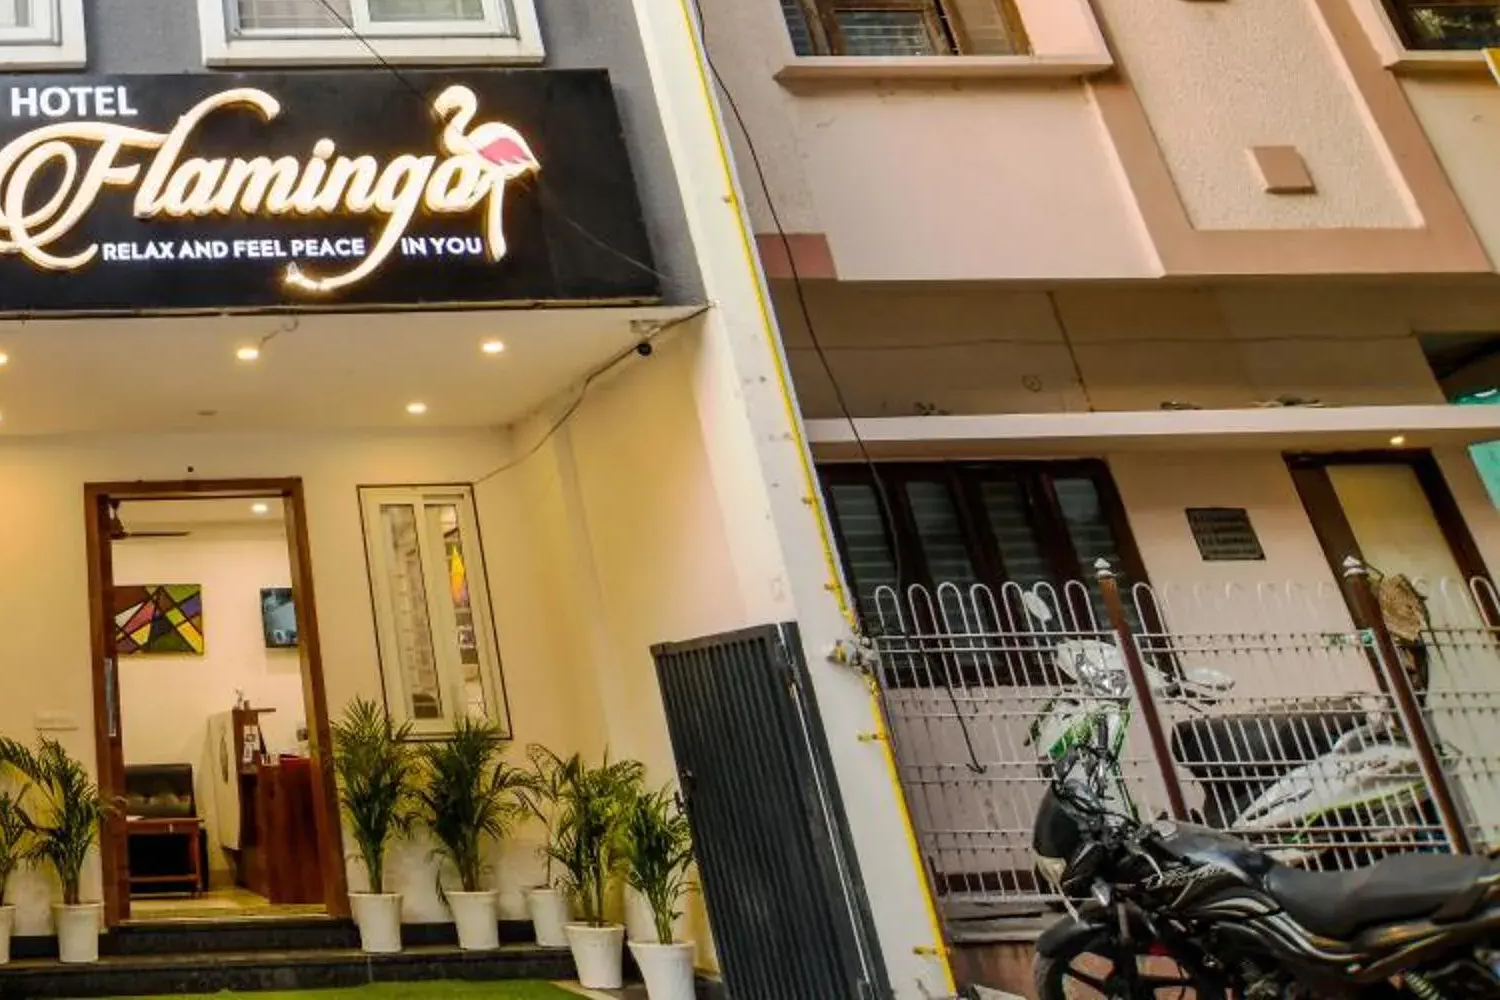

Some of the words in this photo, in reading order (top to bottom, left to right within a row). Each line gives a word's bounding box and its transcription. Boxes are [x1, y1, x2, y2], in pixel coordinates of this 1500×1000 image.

[10, 85, 139, 117] HOTEL
[102, 241, 175, 261] RELAX
[178, 240, 229, 260] AND
[232, 239, 288, 259] FEEL
[290, 237, 367, 257] PEACE
[401, 236, 427, 256] IN
[429, 236, 483, 256] YOU
